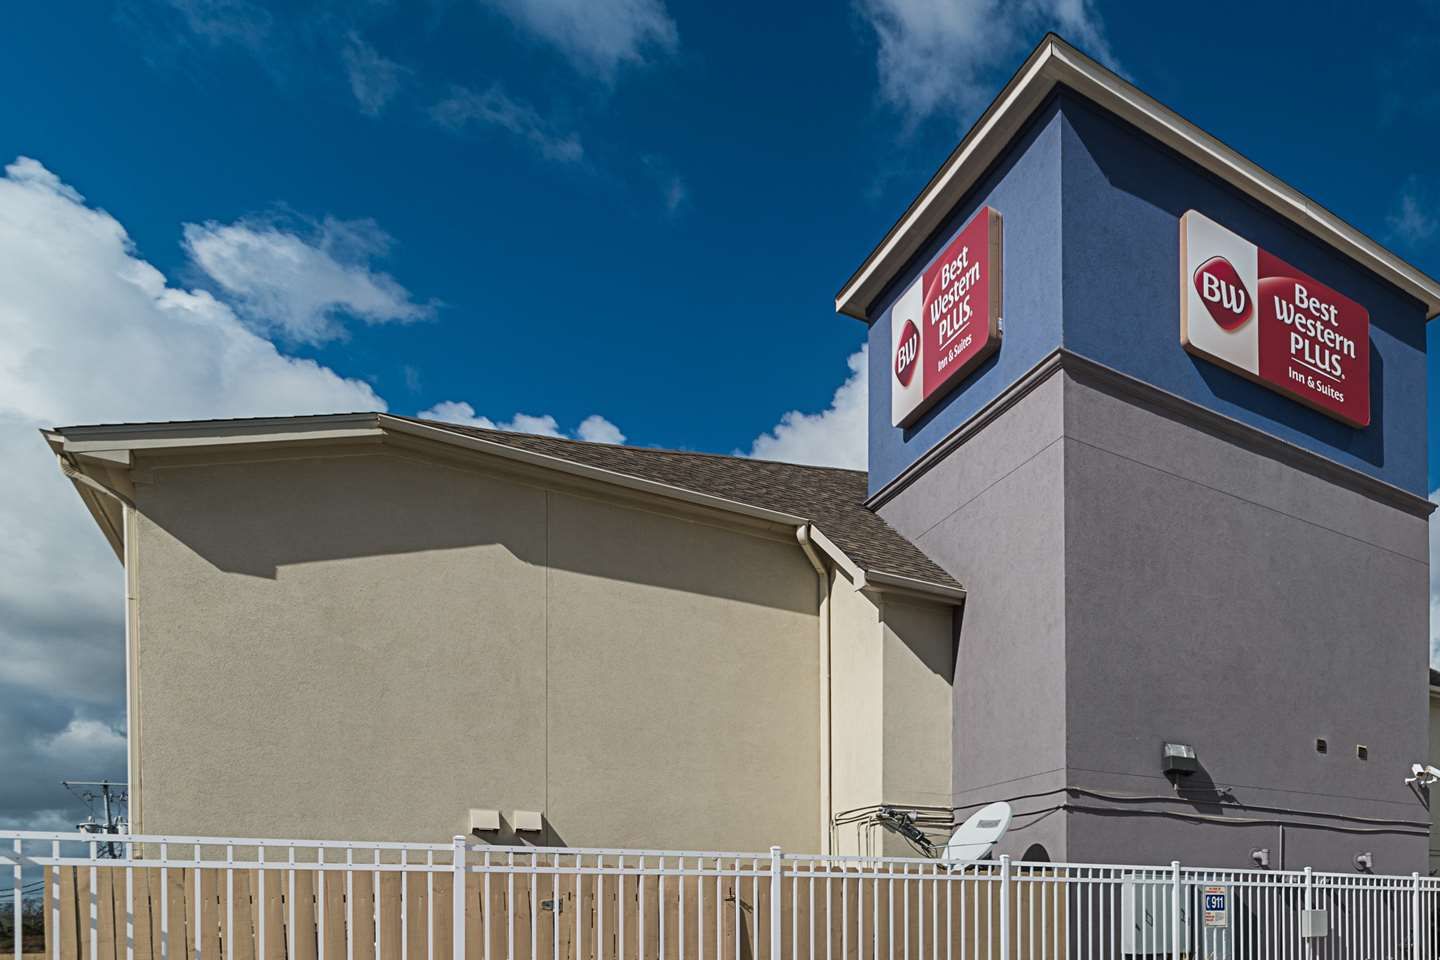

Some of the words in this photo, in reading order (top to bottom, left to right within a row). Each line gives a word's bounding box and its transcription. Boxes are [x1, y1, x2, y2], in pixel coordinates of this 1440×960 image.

[942, 246, 968, 290] Best
[930, 262, 980, 325] Western
[1203, 271, 1245, 314] BW
[1295, 283, 1339, 327] Best
[1274, 295, 1356, 359] Western
[898, 333, 917, 373] BW
[937, 359, 948, 372] Inn
[954, 334, 972, 357] Suites
[1288, 366, 1305, 384] Inn
[1307, 376, 1315, 389] &
[1316, 381, 1344, 402] Suites
[1211, 895, 1224, 909] 911
